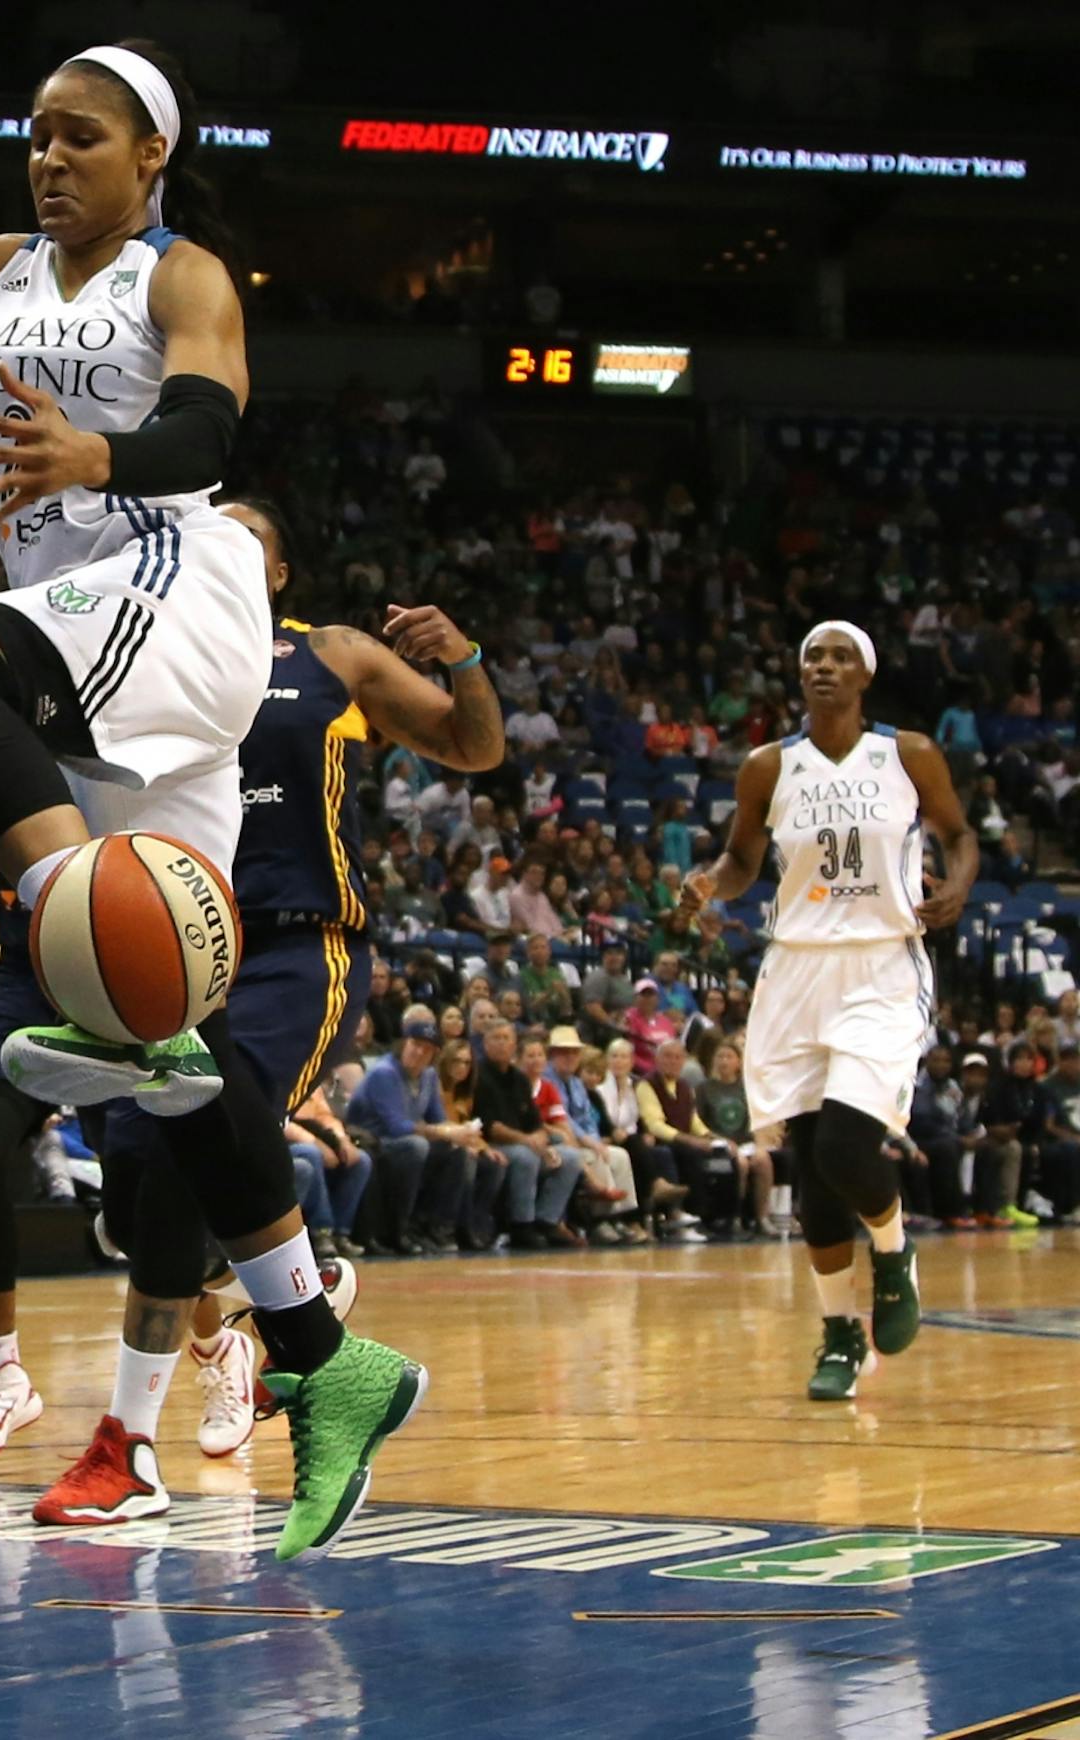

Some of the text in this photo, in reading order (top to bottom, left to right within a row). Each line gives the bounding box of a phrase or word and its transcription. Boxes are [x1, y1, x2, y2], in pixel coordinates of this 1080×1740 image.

[342, 120, 635, 161] FEDERATED INSURANCE
[506, 348, 573, 383] 2:16
[800, 779, 880, 807] MAYO
[793, 802, 888, 830] CLINIC
[817, 826, 863, 880] 34
[831, 883, 880, 898] boost
[166, 857, 229, 1002] SPALDING
